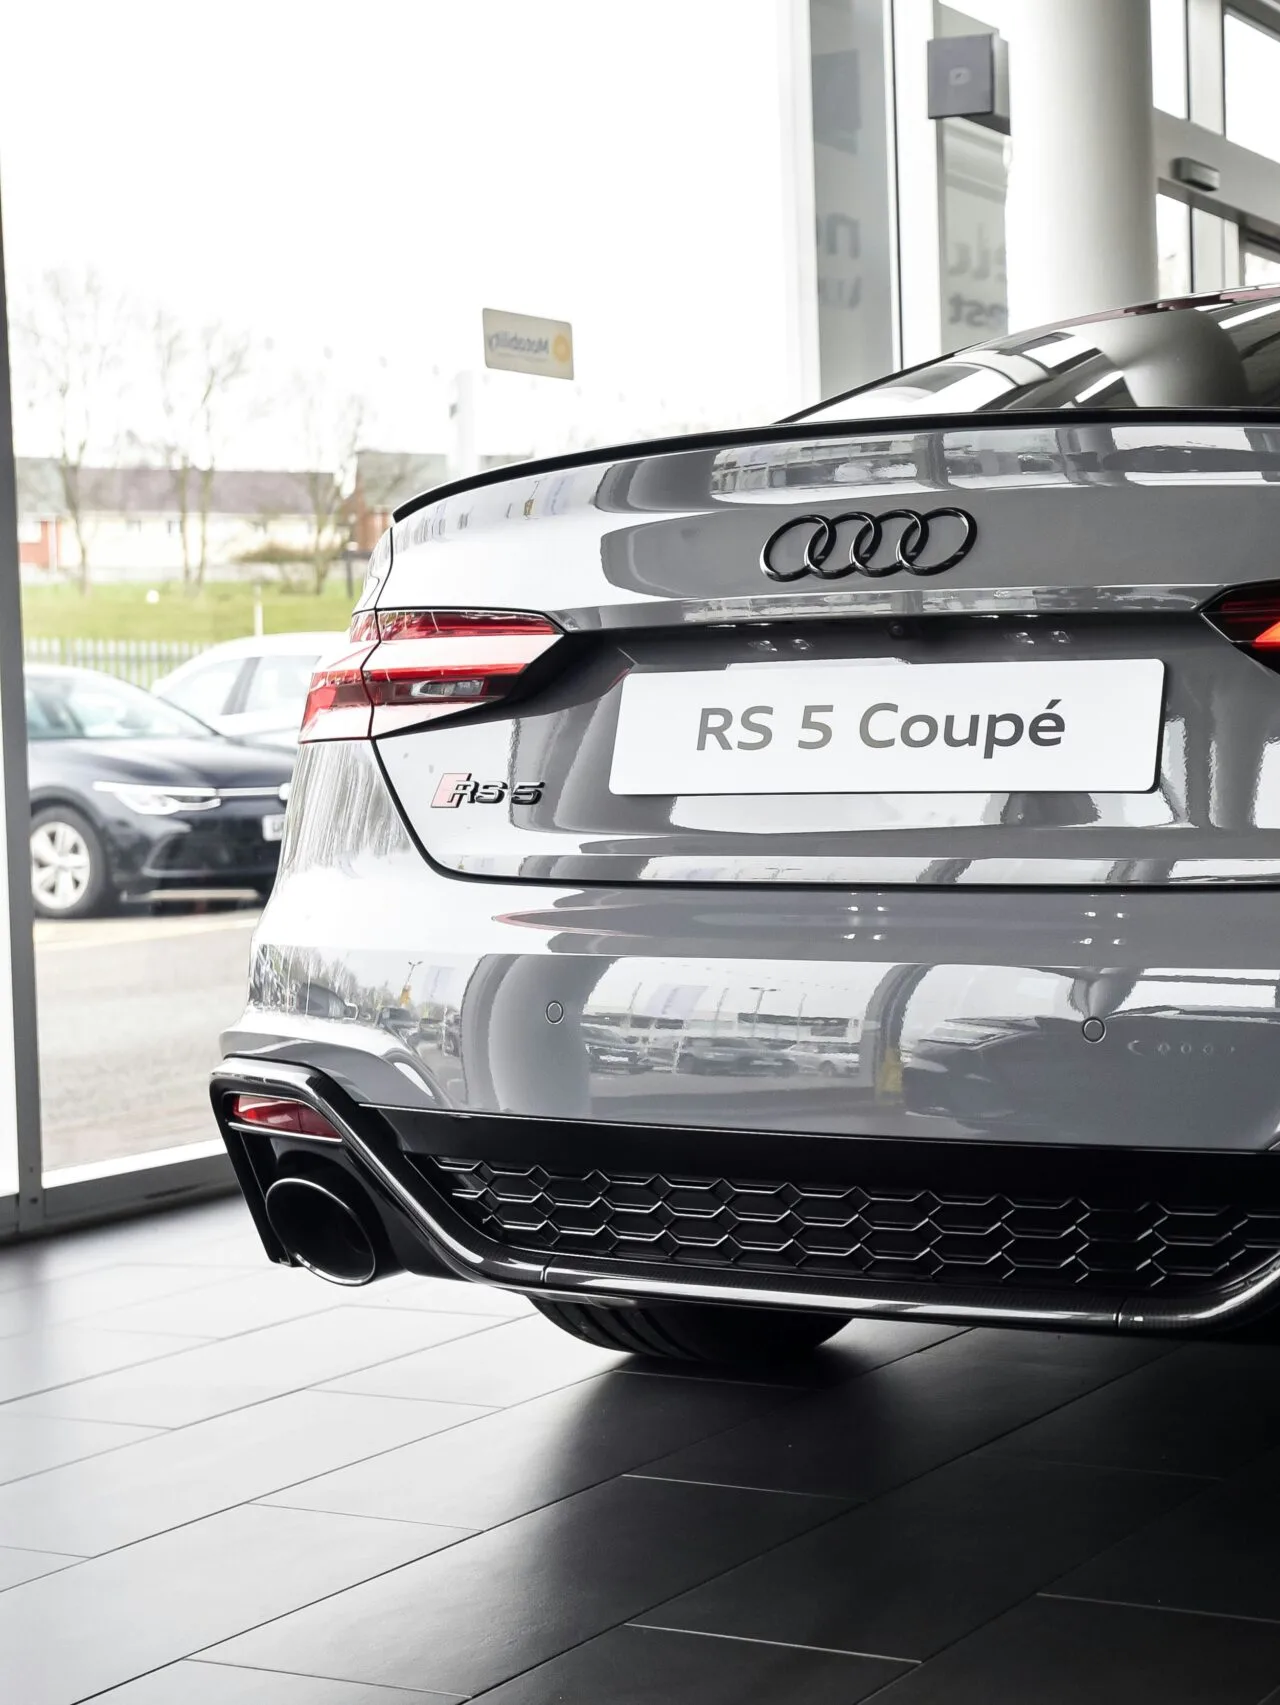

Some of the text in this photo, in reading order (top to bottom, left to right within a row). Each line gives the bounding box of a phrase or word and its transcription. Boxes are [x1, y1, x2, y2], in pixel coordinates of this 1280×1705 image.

[697, 699, 1066, 759] RS 5 Coupé
